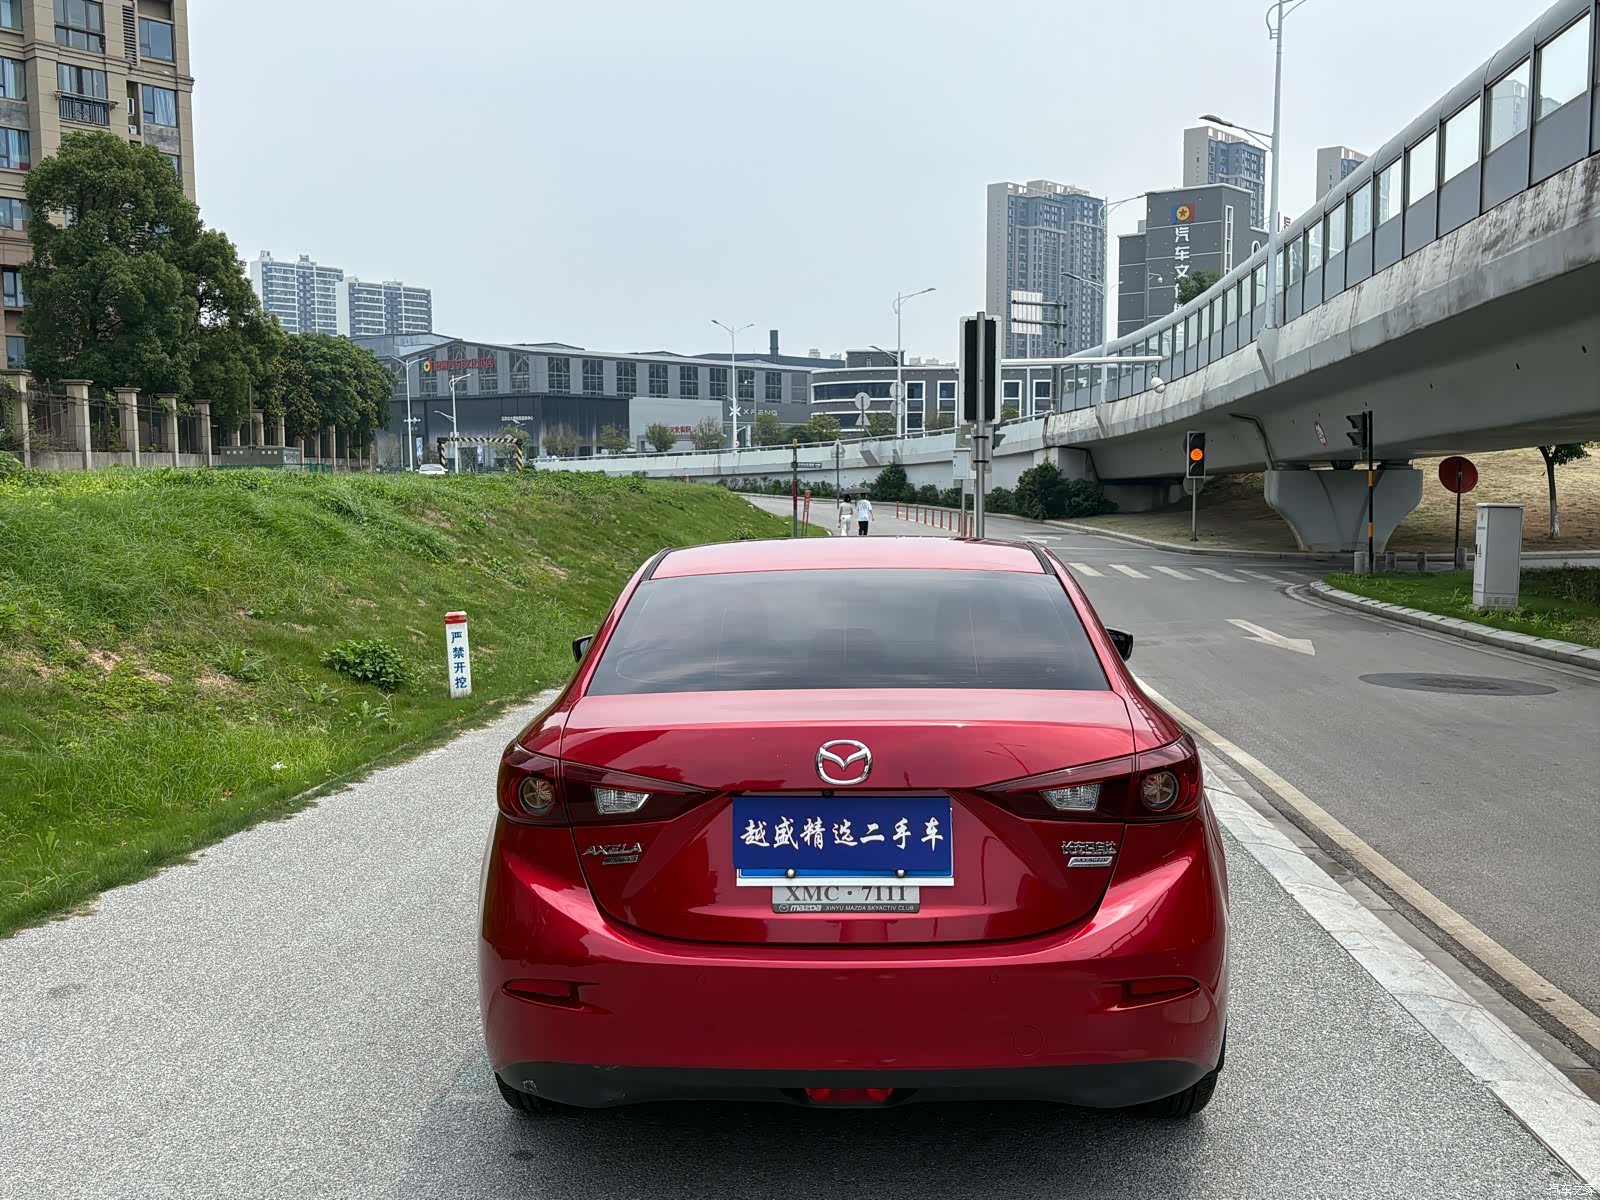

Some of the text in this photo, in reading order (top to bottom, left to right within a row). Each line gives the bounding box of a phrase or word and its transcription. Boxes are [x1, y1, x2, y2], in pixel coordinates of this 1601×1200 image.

[1174, 227, 1190, 312] 汽车文
[451, 631, 468, 689] 严禁开挖
[740, 816, 944, 851] 越盛精选二手车
[581, 842, 643, 856] AXELA
[785, 886, 840, 902] XMC
[861, 886, 907, 902] 7111
[790, 904, 822, 912] mazda
